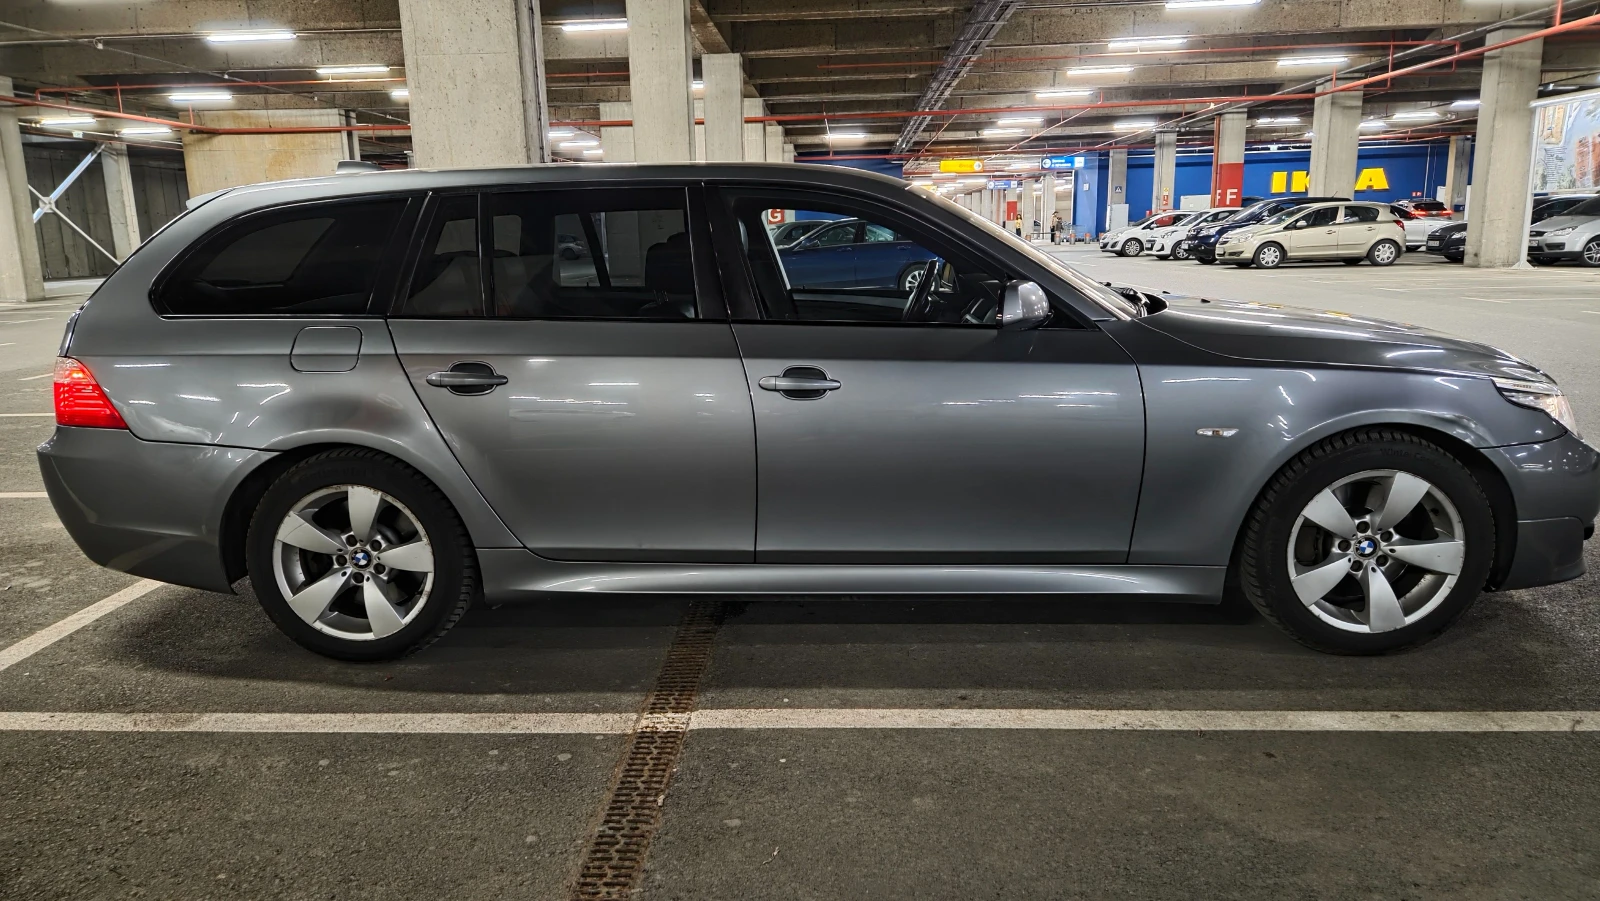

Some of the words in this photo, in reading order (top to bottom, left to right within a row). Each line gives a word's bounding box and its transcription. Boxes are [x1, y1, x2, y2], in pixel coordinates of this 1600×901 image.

[1271, 168, 1389, 193] IKA
[1226, 188, 1238, 205] F
[768, 209, 782, 222] G
